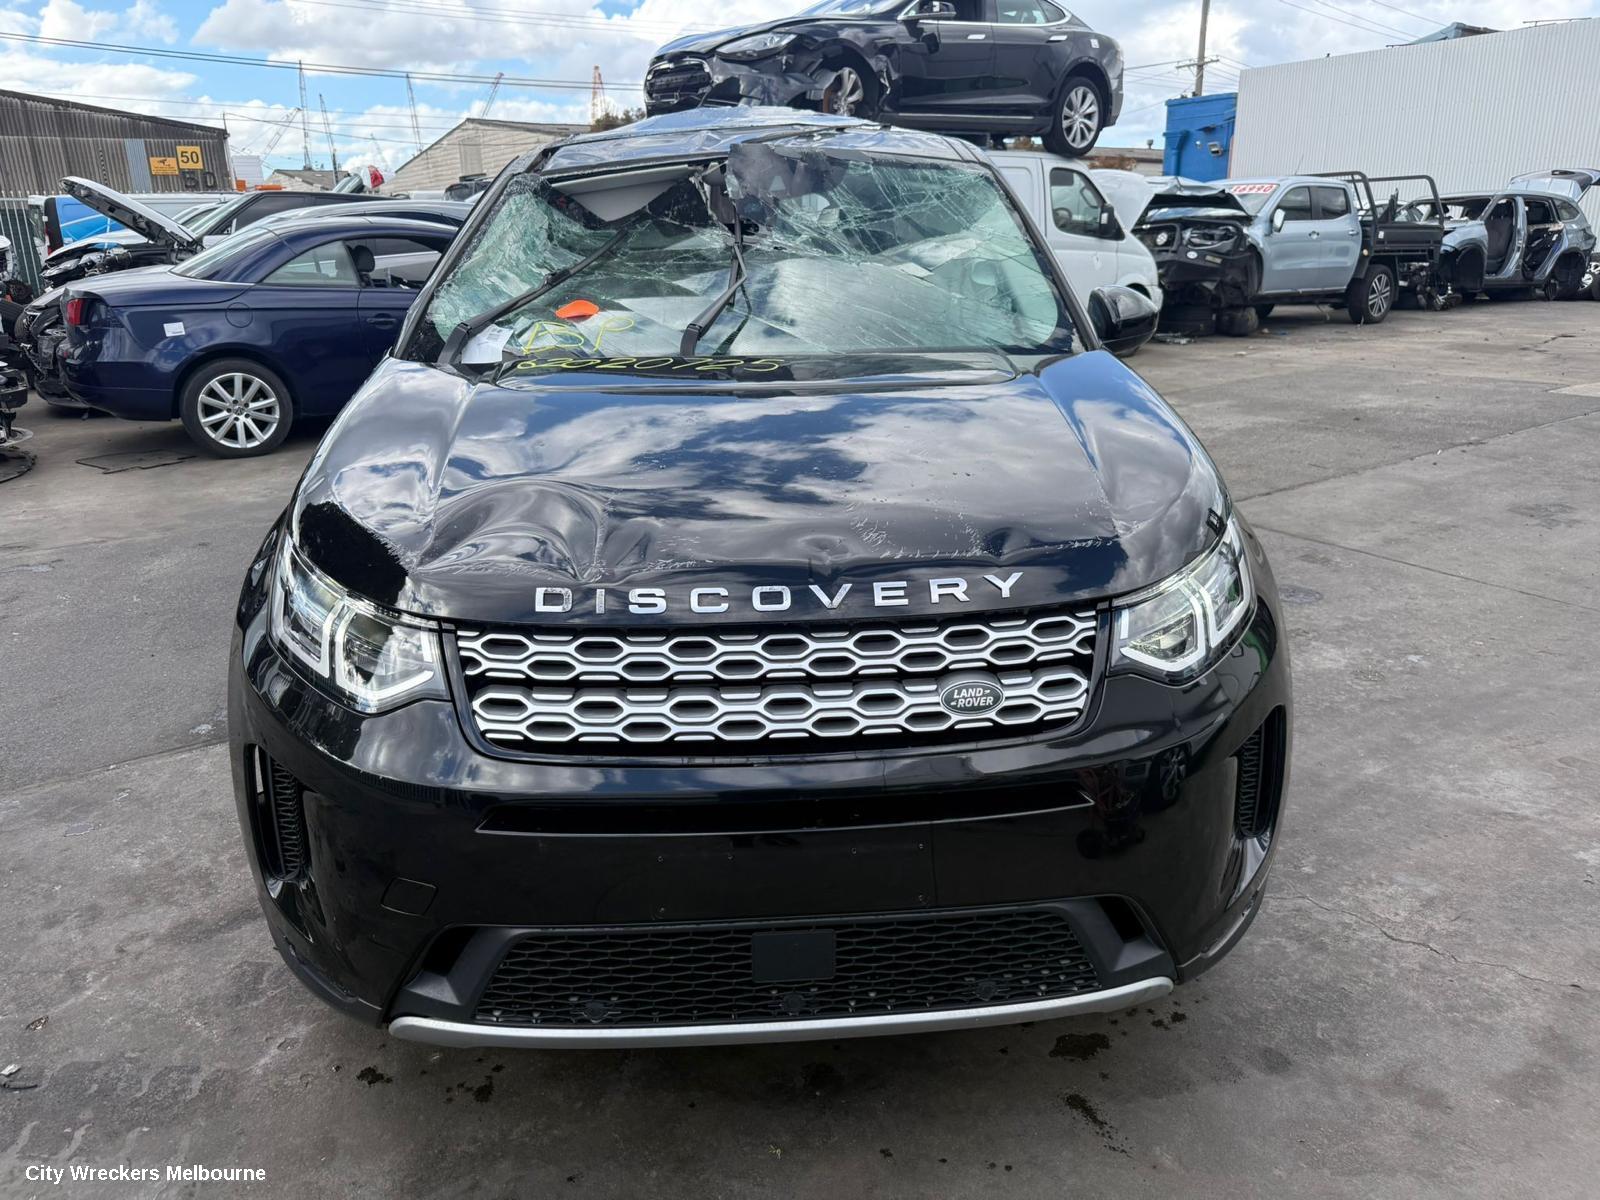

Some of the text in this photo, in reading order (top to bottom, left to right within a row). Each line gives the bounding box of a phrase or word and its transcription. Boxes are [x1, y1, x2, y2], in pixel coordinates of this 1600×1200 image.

[180, 151, 199, 164] 50
[535, 571, 1024, 615] DISCOVERY
[953, 687, 984, 699] LAND
[957, 696, 994, 708] ROVER
